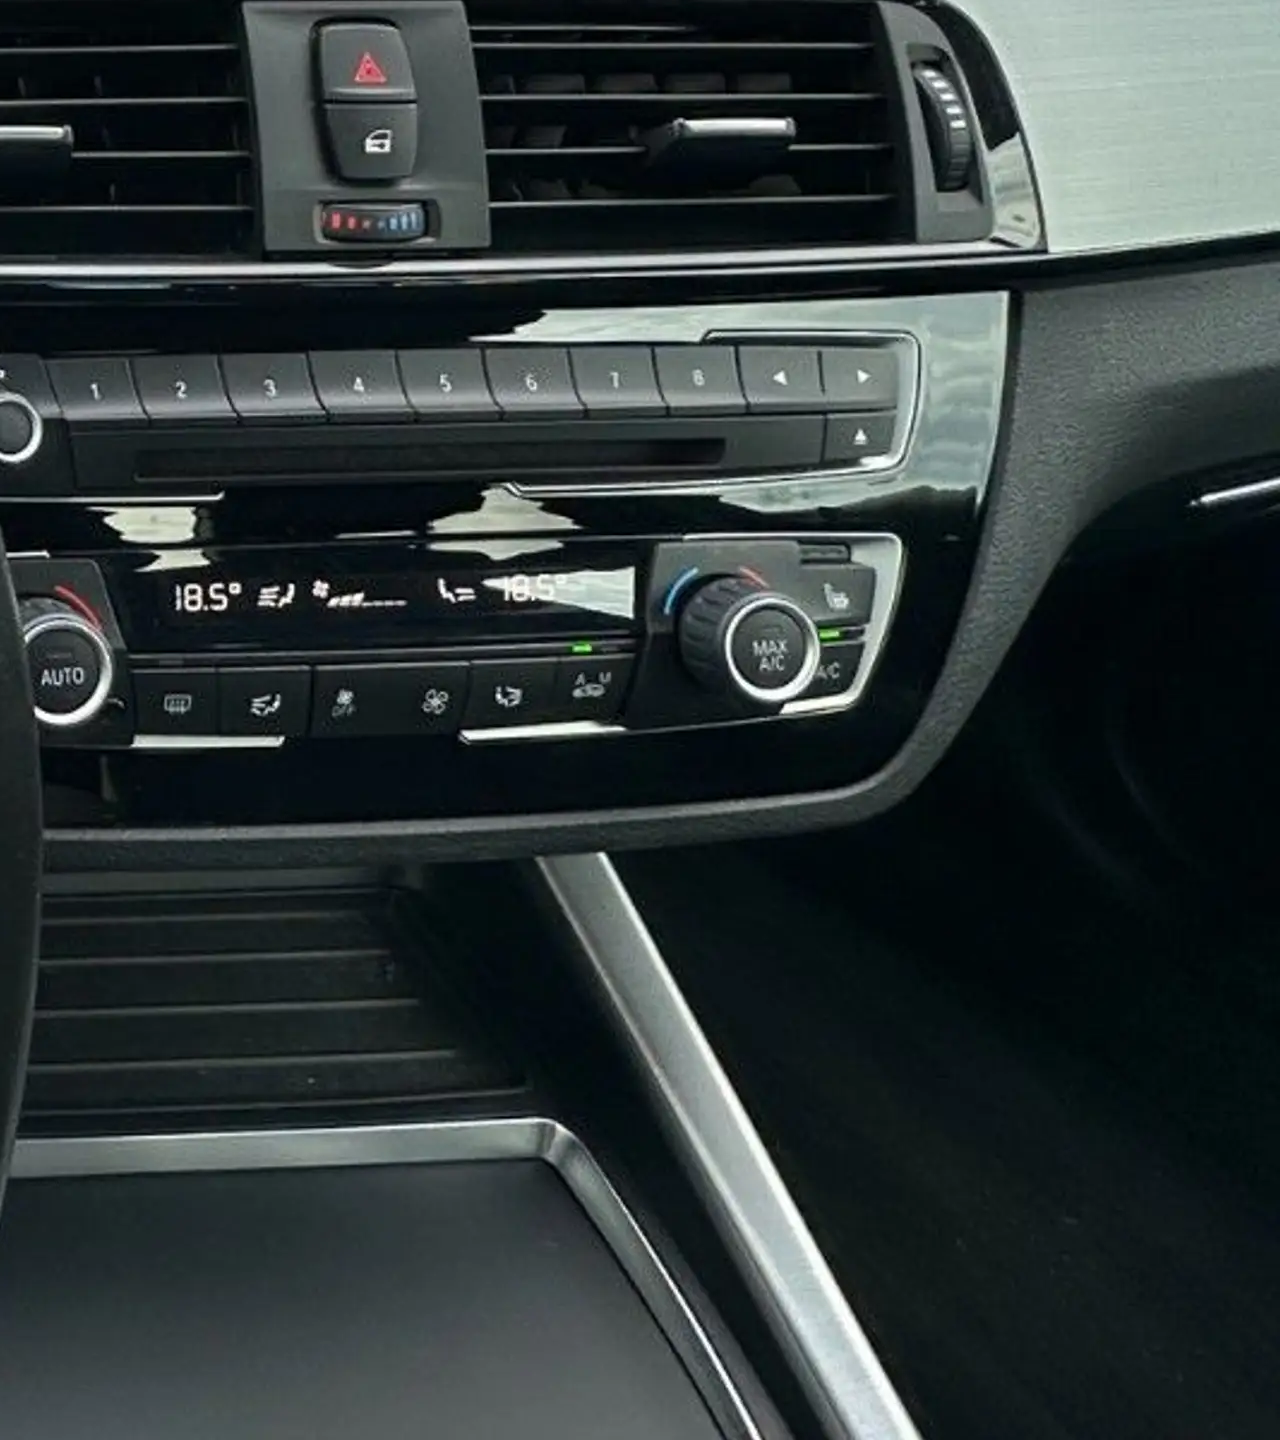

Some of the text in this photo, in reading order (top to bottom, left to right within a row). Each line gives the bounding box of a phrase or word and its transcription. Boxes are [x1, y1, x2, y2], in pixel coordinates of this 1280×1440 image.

[353, 376, 365, 393] 4
[439, 373, 452, 393] 5
[524, 373, 538, 391] 6
[692, 369, 705, 386] 8
[90, 382, 101, 401] 1
[175, 380, 188, 399] 2
[263, 378, 277, 398] 3
[751, 639, 789, 657] MAX
[40, 666, 85, 686] AUTO
